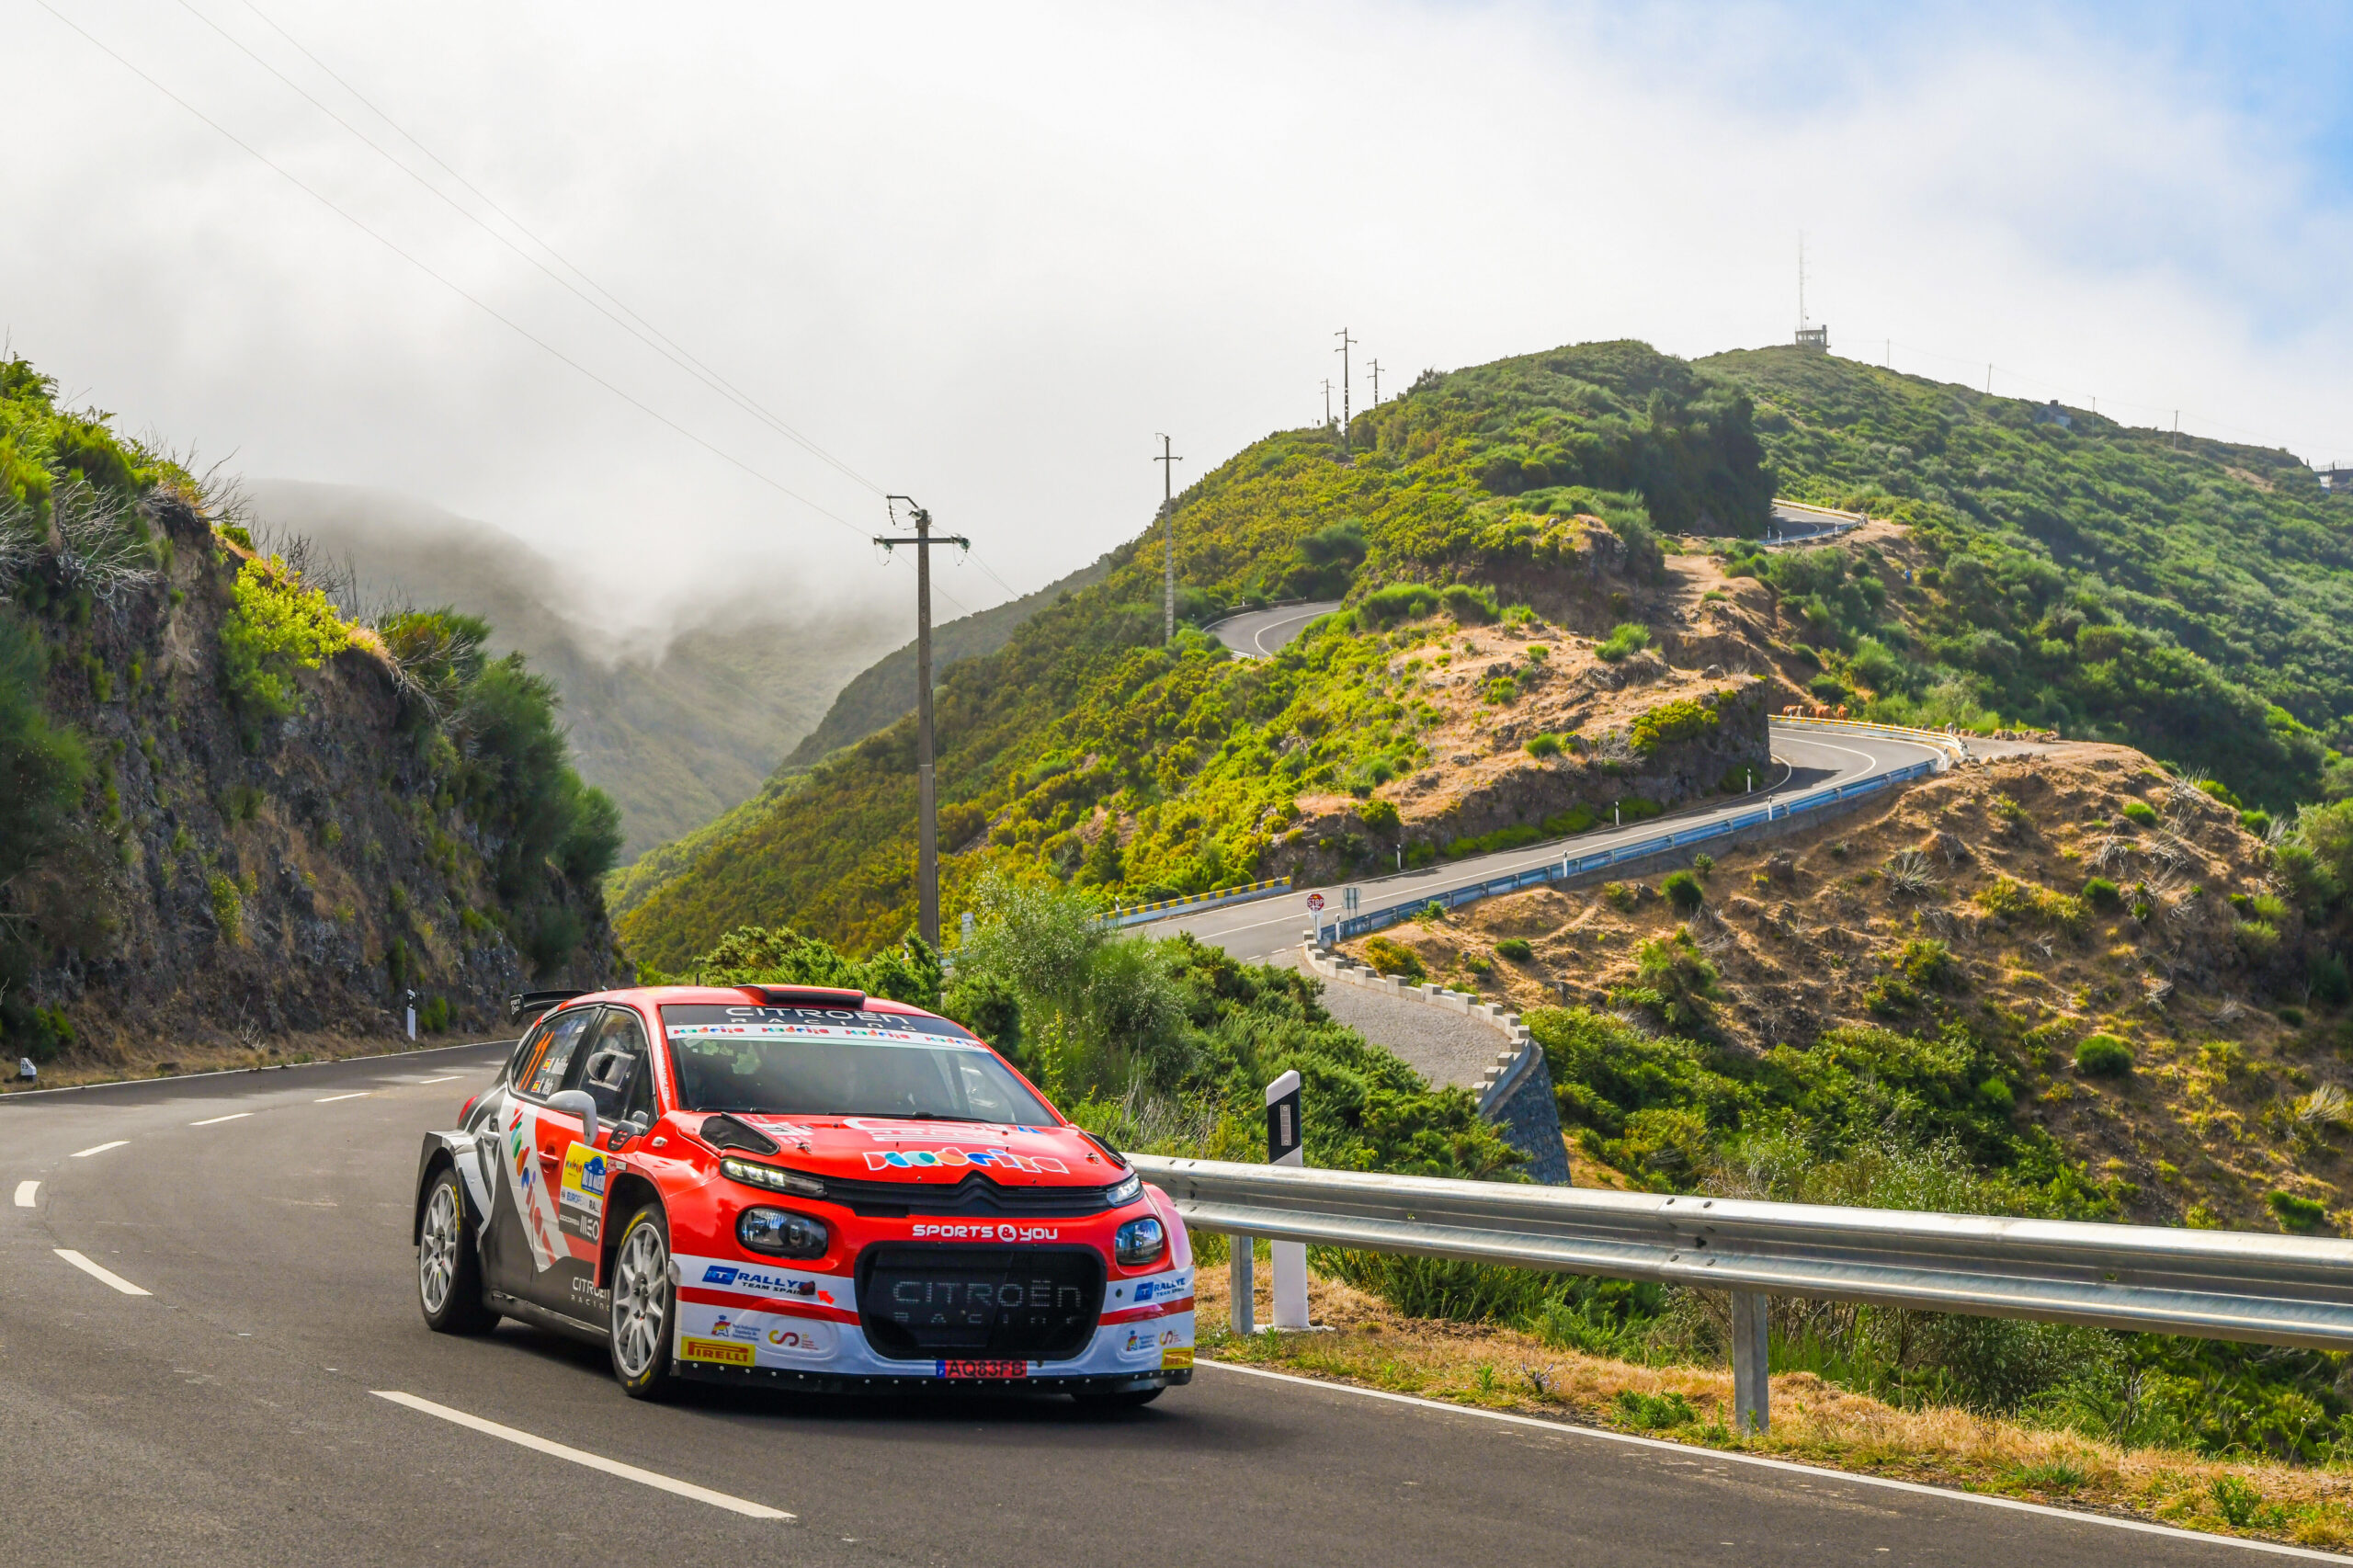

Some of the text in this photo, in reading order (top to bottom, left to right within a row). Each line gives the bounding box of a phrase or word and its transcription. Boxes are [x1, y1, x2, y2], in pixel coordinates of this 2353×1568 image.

[731, 1017, 916, 1031] RACING
[580, 1214, 600, 1241] MEO
[912, 1224, 994, 1239] SPORTS
[1019, 1227, 1058, 1242] YOU
[742, 1281, 769, 1290] TEAM
[688, 1341, 750, 1363] PIRELLI
[948, 1360, 1025, 1378] AQ83FB
